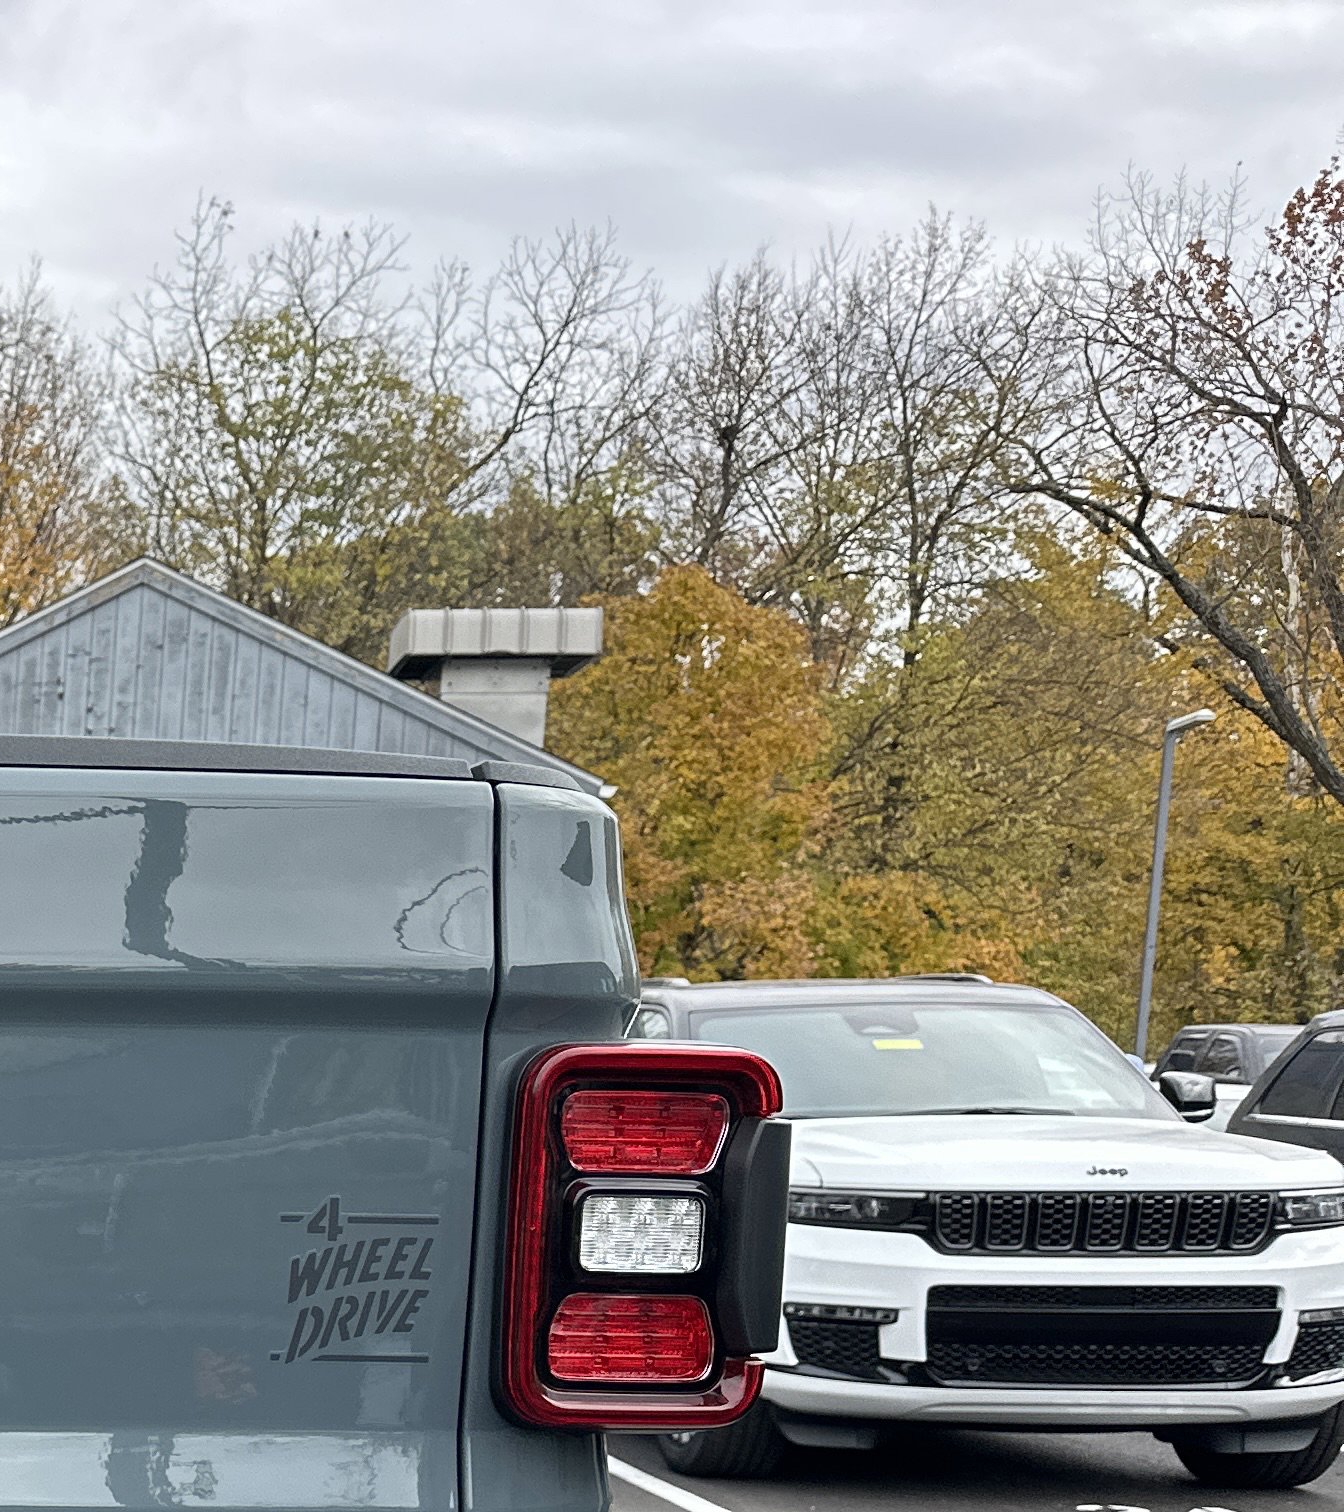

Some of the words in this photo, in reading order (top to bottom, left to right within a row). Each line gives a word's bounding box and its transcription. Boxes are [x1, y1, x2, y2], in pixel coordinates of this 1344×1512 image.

[1086, 1165, 1128, 1177] Jeep
[306, 1195, 343, 1241] 4
[287, 1237, 434, 1304] WHEEL
[285, 1289, 430, 1364] DRIVE
